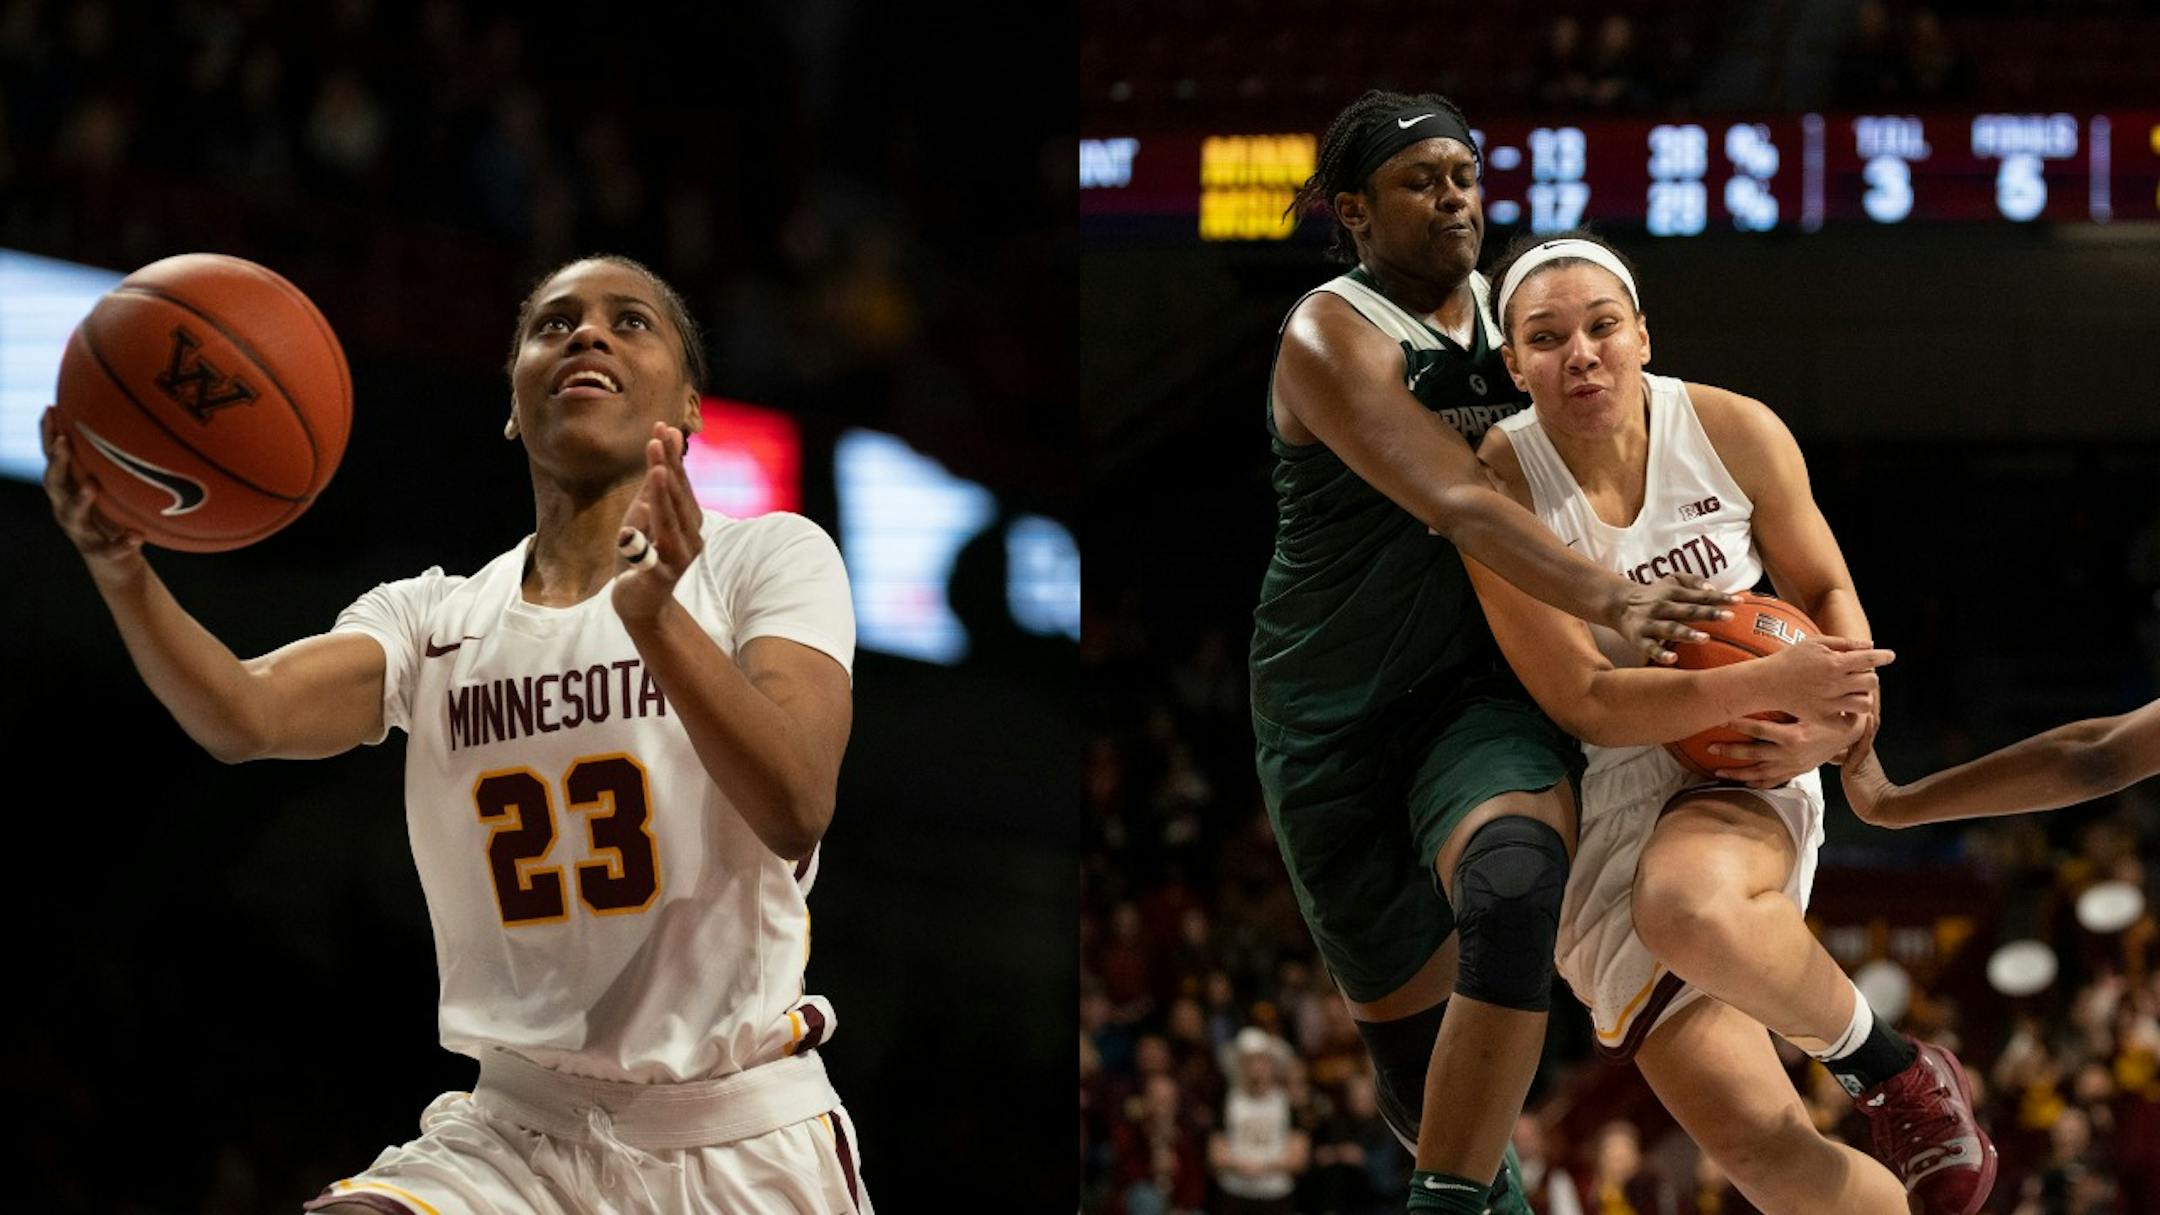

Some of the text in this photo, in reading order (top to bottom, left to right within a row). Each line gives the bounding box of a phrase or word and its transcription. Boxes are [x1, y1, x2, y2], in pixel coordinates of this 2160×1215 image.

[1863, 155, 1914, 223] 3
[447, 659, 666, 750] MINNESOTA
[472, 751, 661, 927] 23
